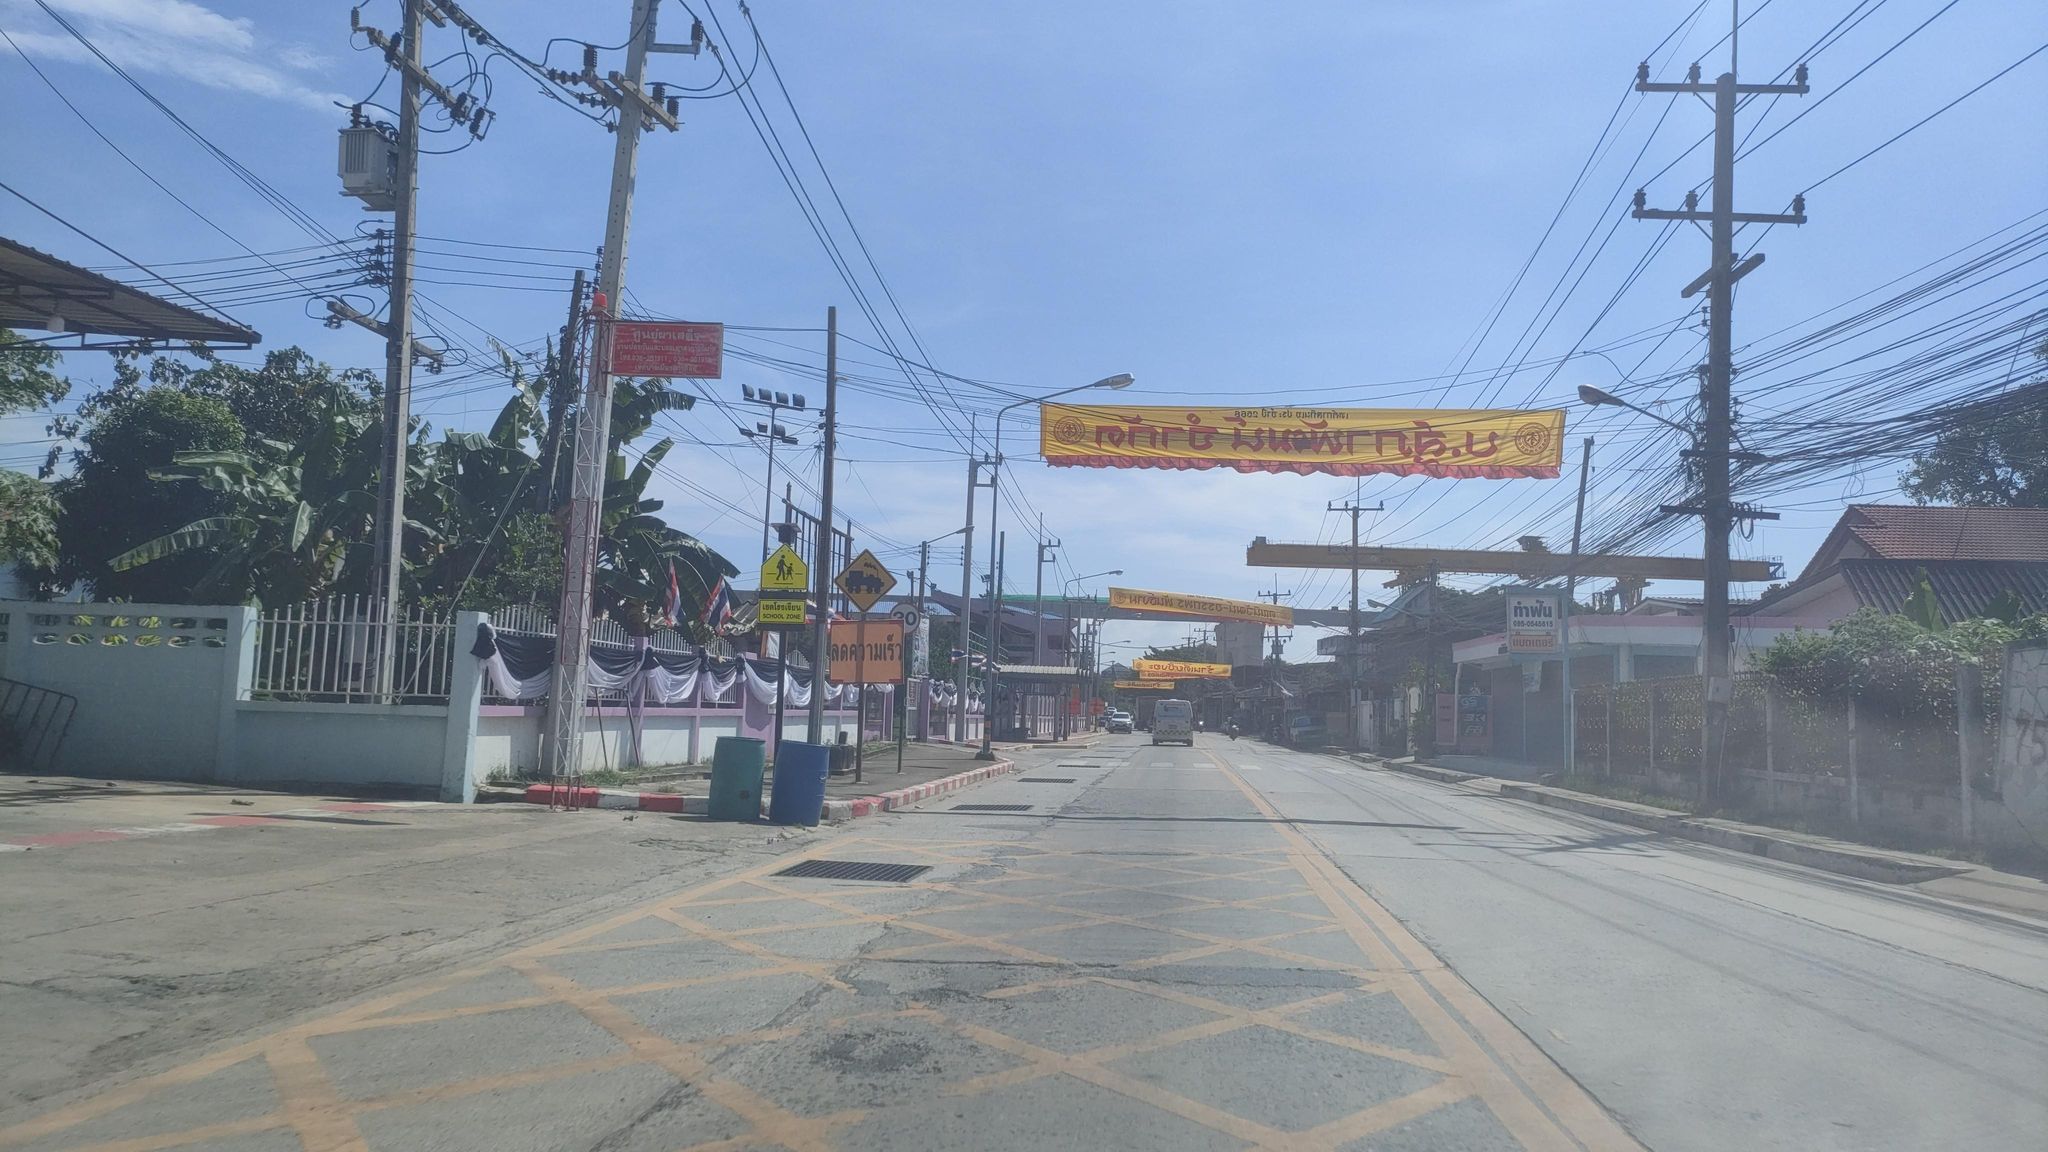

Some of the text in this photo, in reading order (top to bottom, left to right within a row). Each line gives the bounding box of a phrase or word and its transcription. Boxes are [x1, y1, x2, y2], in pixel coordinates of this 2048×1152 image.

[762, 602, 802, 612] เขตโรงเรียน
[1513, 599, 1552, 618] ทำฟัน
[831, 634, 903, 662] ลดความเร็ว
